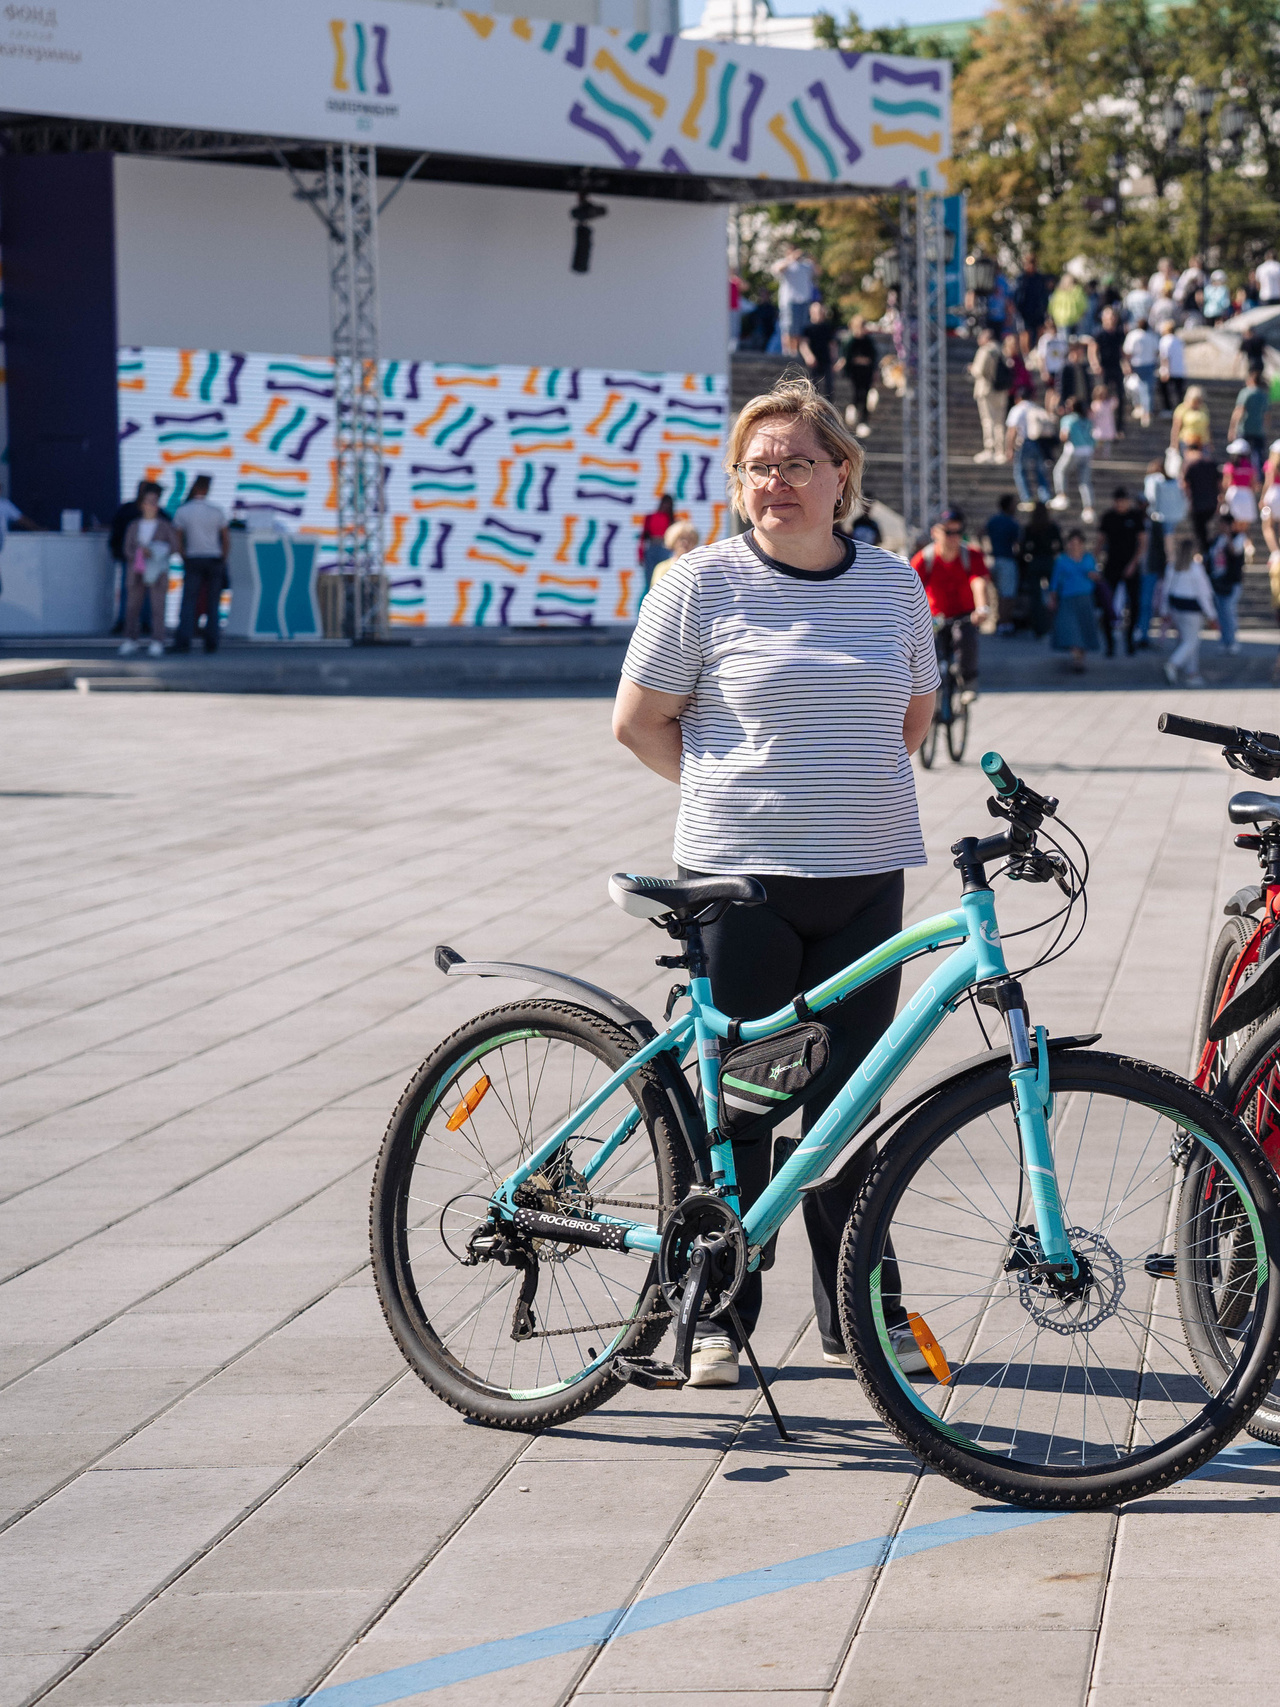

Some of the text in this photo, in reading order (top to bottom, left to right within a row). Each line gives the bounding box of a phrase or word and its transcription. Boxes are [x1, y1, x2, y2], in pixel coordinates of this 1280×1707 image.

[815, 986, 936, 1143] STELS
[538, 1213, 602, 1233] ROCKBROS
[682, 1280, 696, 1325] STELS
